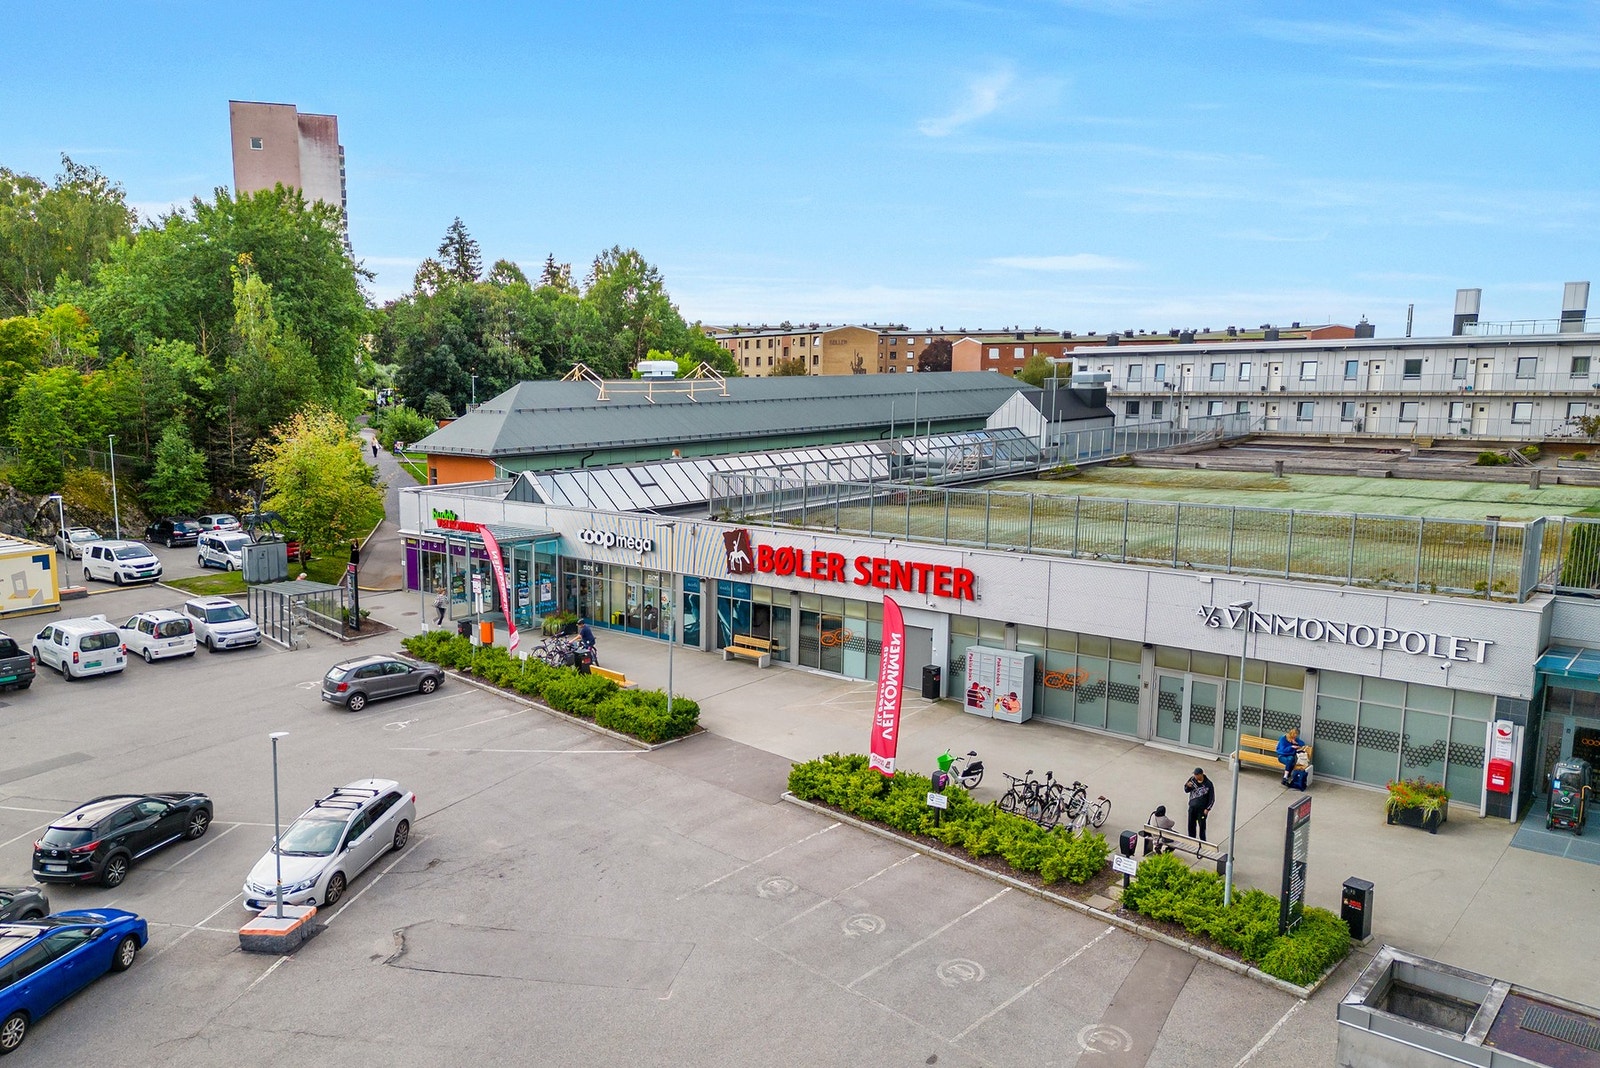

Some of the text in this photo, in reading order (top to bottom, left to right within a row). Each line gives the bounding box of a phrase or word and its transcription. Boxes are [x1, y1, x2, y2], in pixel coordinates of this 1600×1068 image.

[577, 528, 652, 554] coop mega
[757, 544, 846, 583] BØLER
[853, 555, 975, 601] SENTER
[1196, 605, 1494, 664] A/S VINMONOPOLET
